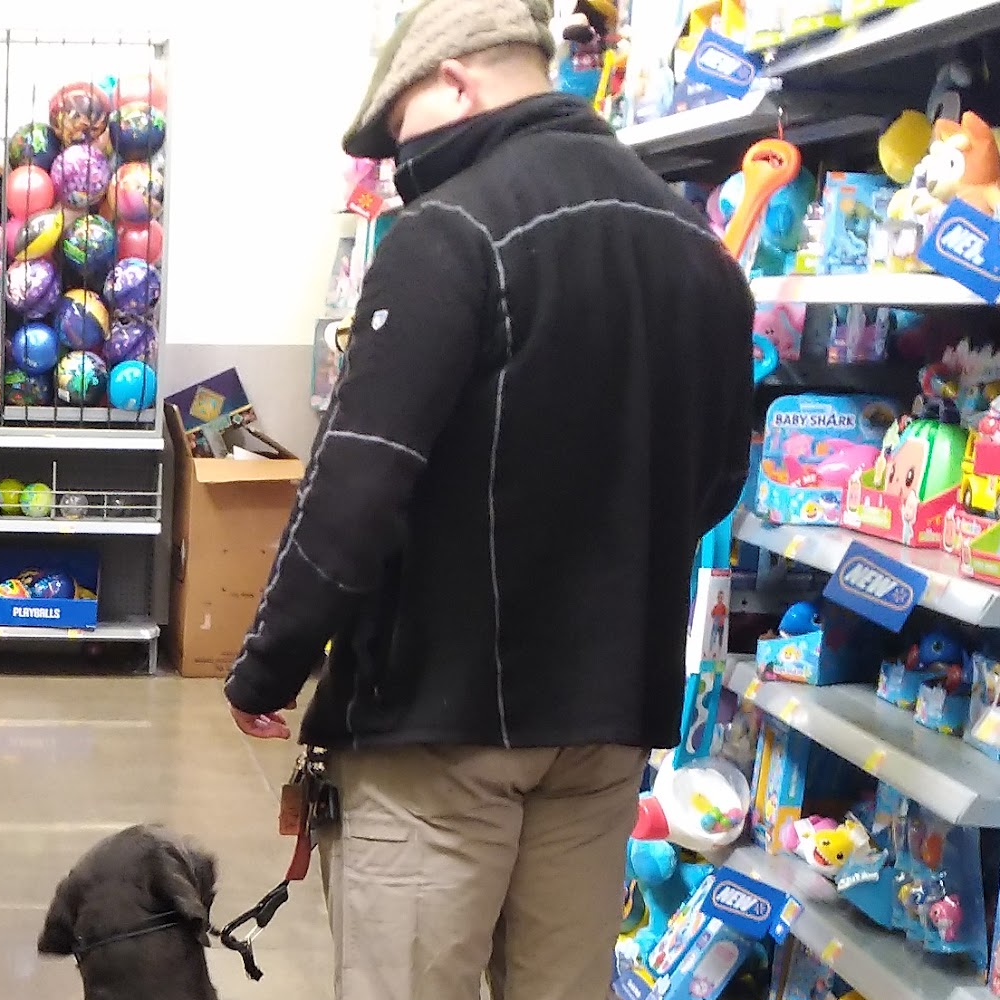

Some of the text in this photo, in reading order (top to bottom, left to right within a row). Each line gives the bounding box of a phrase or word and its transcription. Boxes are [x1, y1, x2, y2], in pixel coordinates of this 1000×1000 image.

[775, 413, 854, 427] BABY SHARK
[844, 562, 898, 598] NEW
[12, 606, 61, 619] PLAYBALLS
[716, 886, 758, 911] NEW
